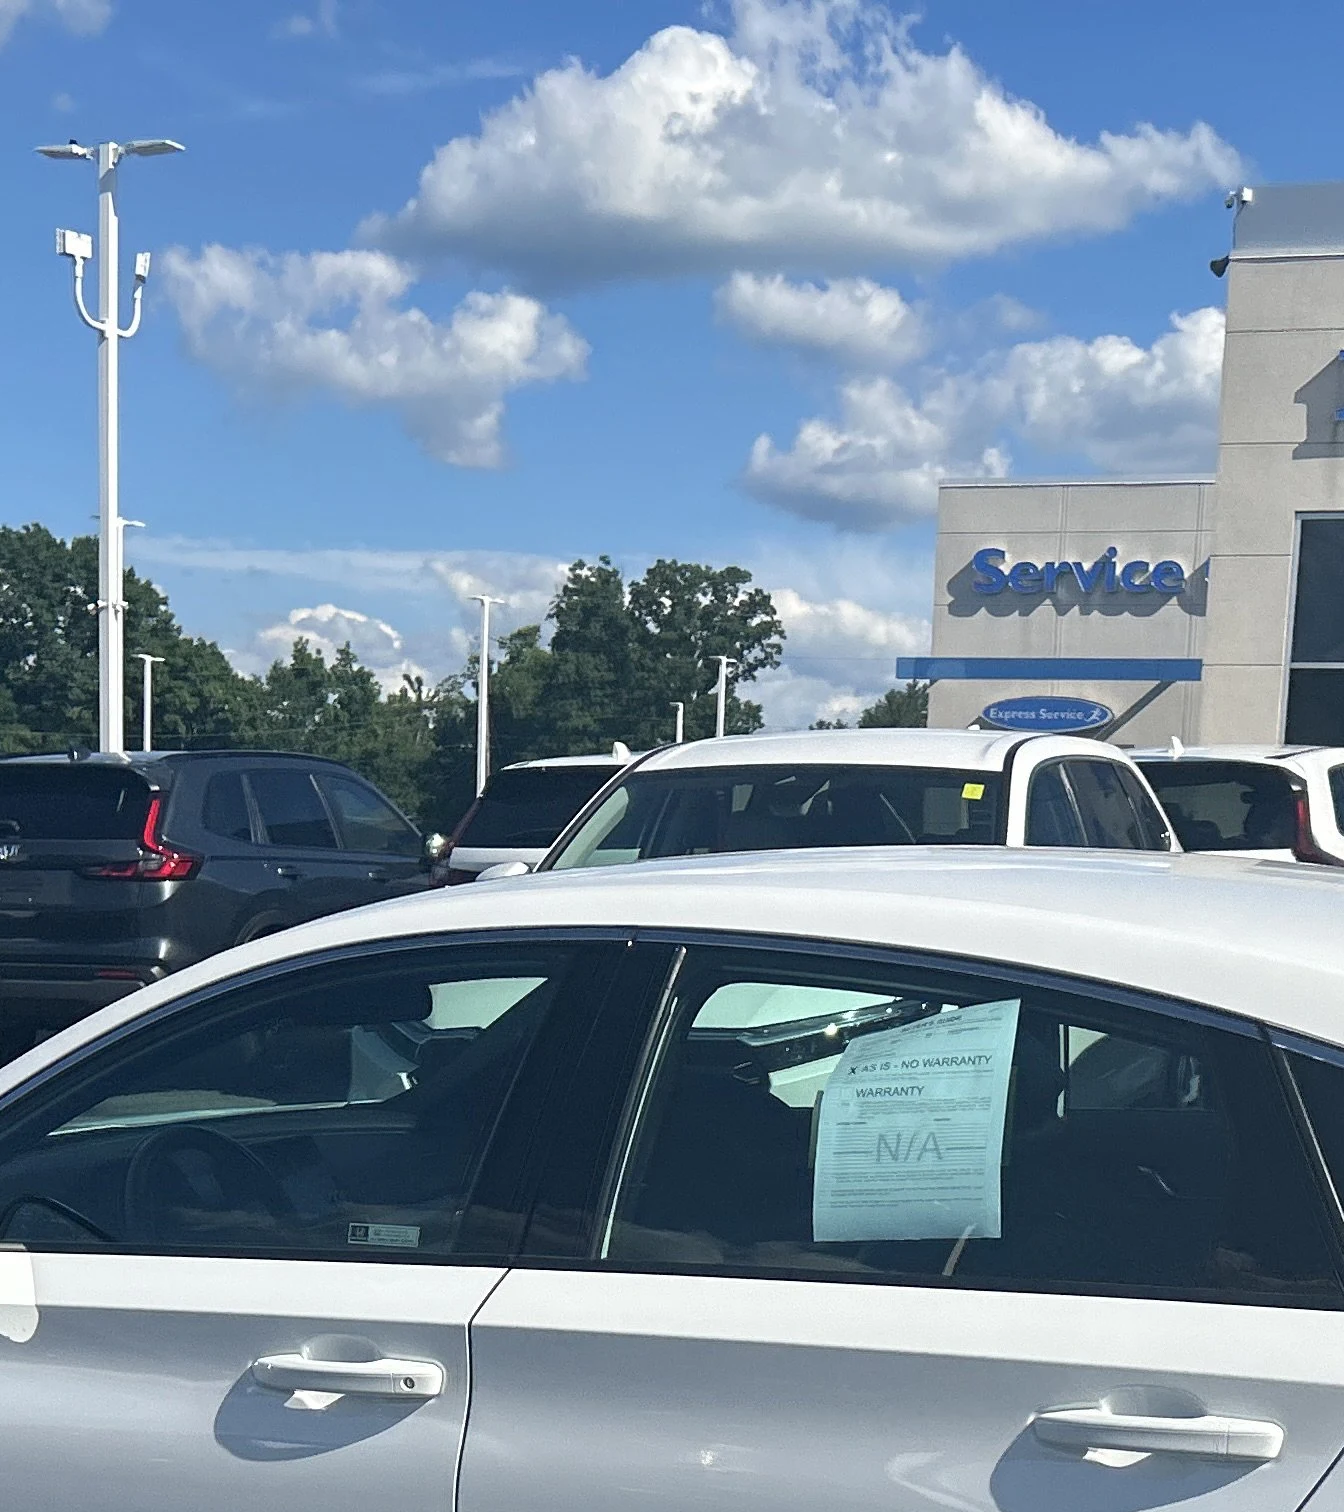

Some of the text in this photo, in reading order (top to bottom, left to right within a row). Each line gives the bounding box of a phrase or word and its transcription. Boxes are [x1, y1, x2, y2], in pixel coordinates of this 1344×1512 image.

[973, 546, 1185, 594] Service
[989, 708, 1085, 721] Express Service
[862, 1063, 878, 1073] AS
[880, 1062, 891, 1071] IS
[901, 1060, 920, 1069] NO
[922, 1055, 993, 1068] WARRANTY
[856, 1086, 925, 1098] WARRANTY
[875, 1131, 944, 1162] N/A
